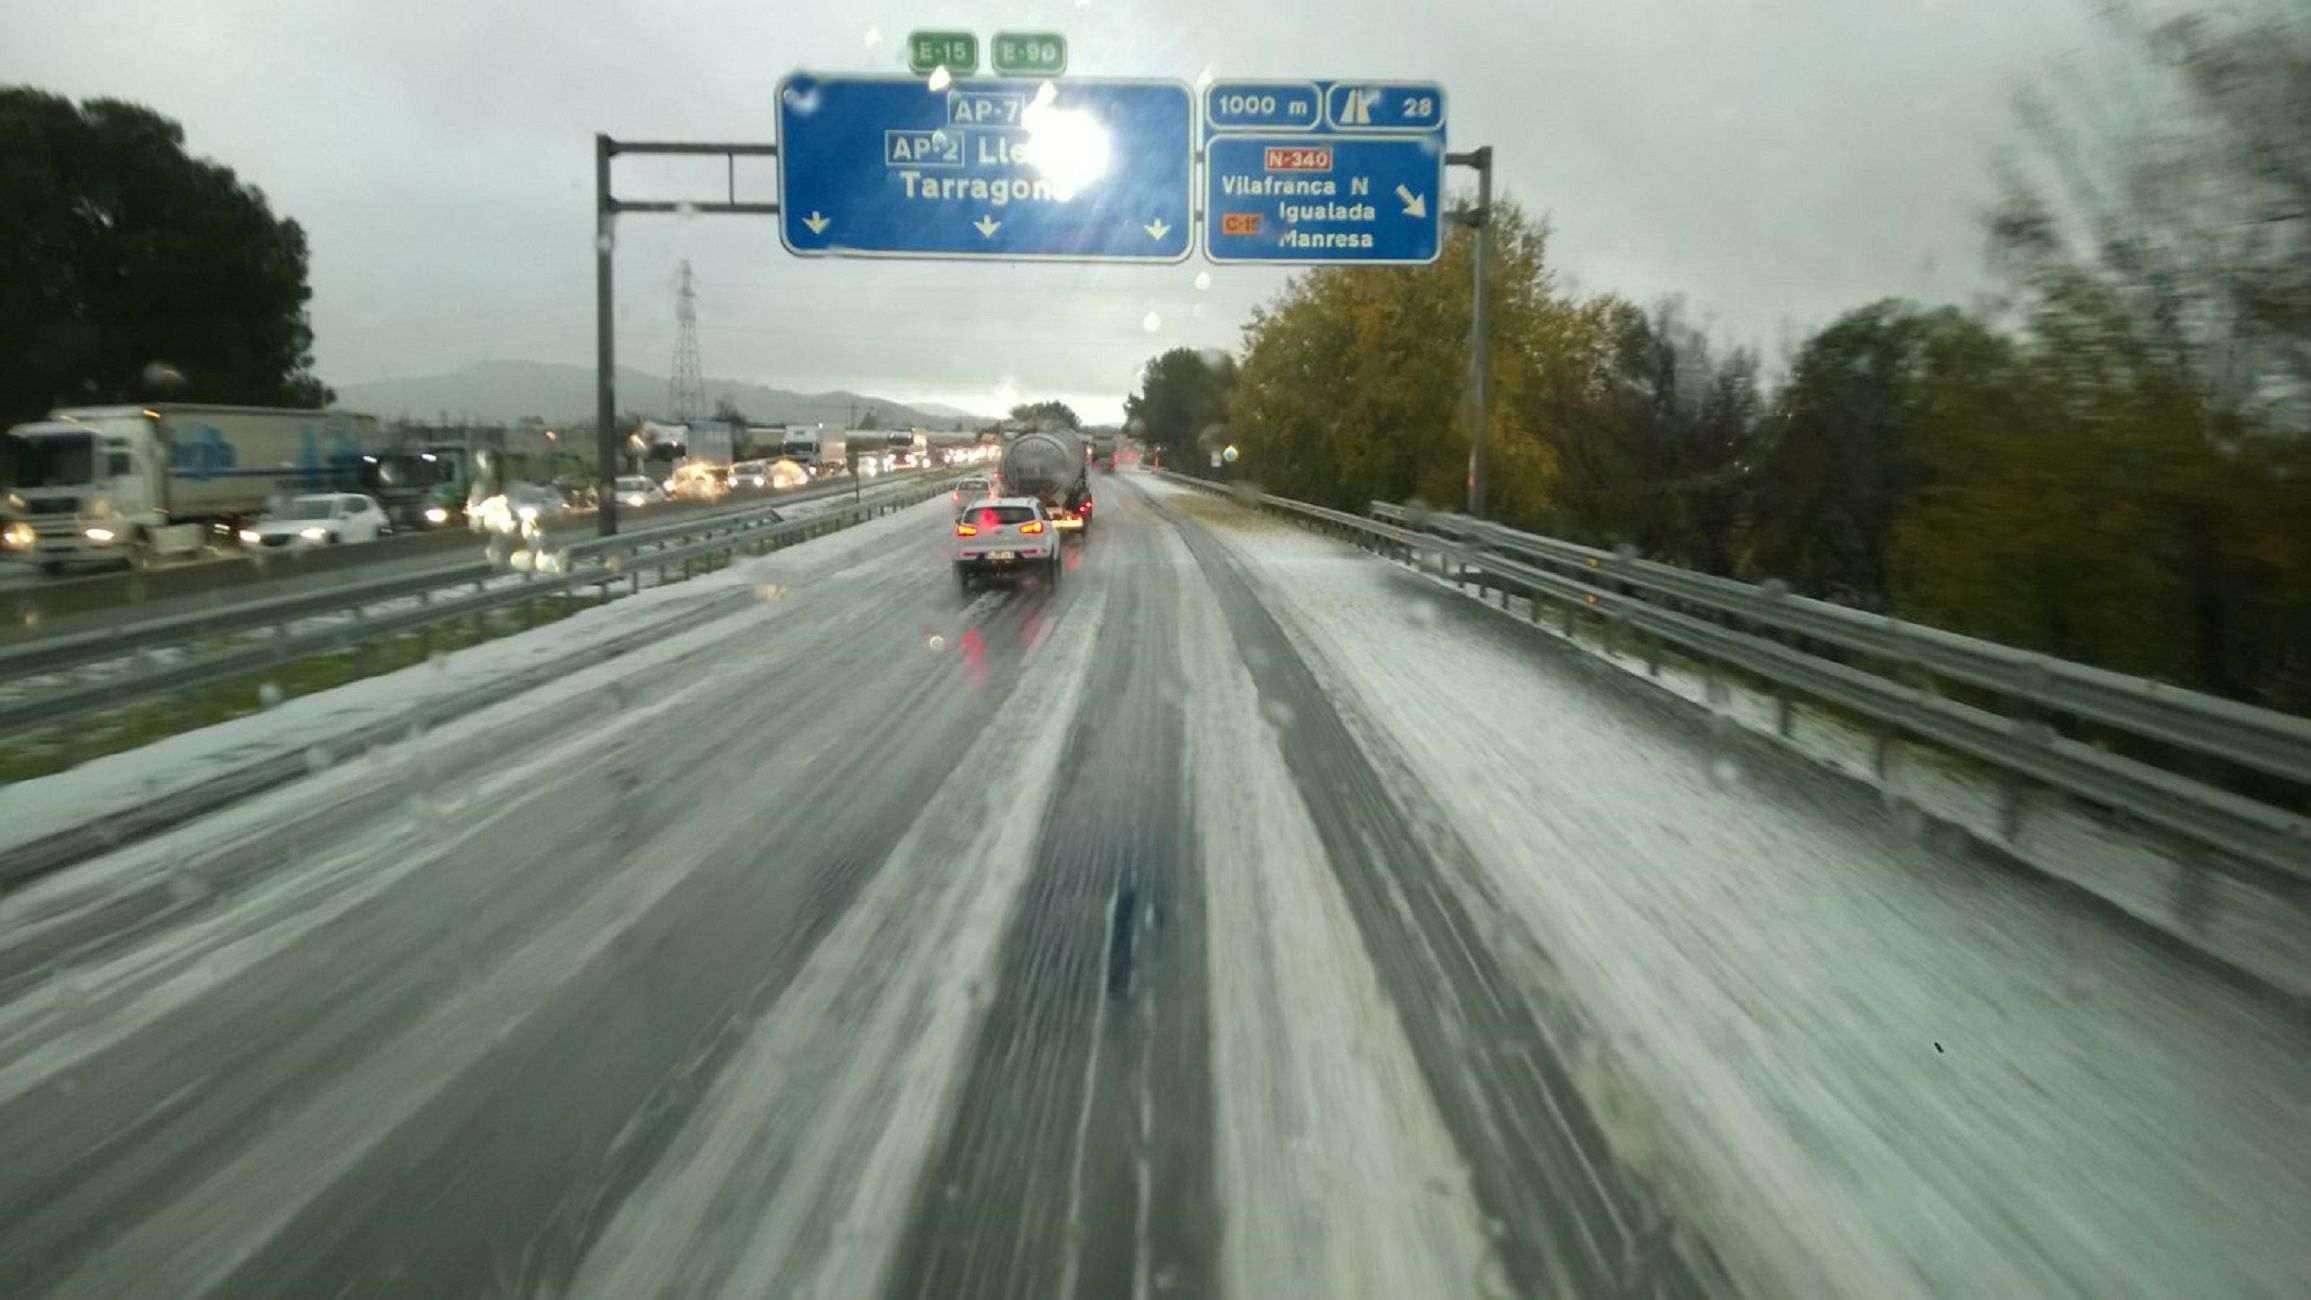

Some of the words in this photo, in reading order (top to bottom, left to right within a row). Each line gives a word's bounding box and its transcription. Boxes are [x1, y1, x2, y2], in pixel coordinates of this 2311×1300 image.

[919, 41, 966, 60] E-15
[1003, 42, 1056, 62] E-90
[954, 99, 1019, 122] AP-7
[1220, 96, 1276, 114] 1000
[1288, 100, 1308, 115] m
[1402, 97, 1432, 117] 28
[893, 136, 959, 161] AP-2
[1268, 151, 1328, 167] N-340
[900, 170, 1071, 206] Tarragon
[1221, 176, 1337, 195] Vilafranca
[1351, 177, 1370, 195] N
[1279, 201, 1376, 223] Igualada
[1278, 229, 1374, 248] Manresa
